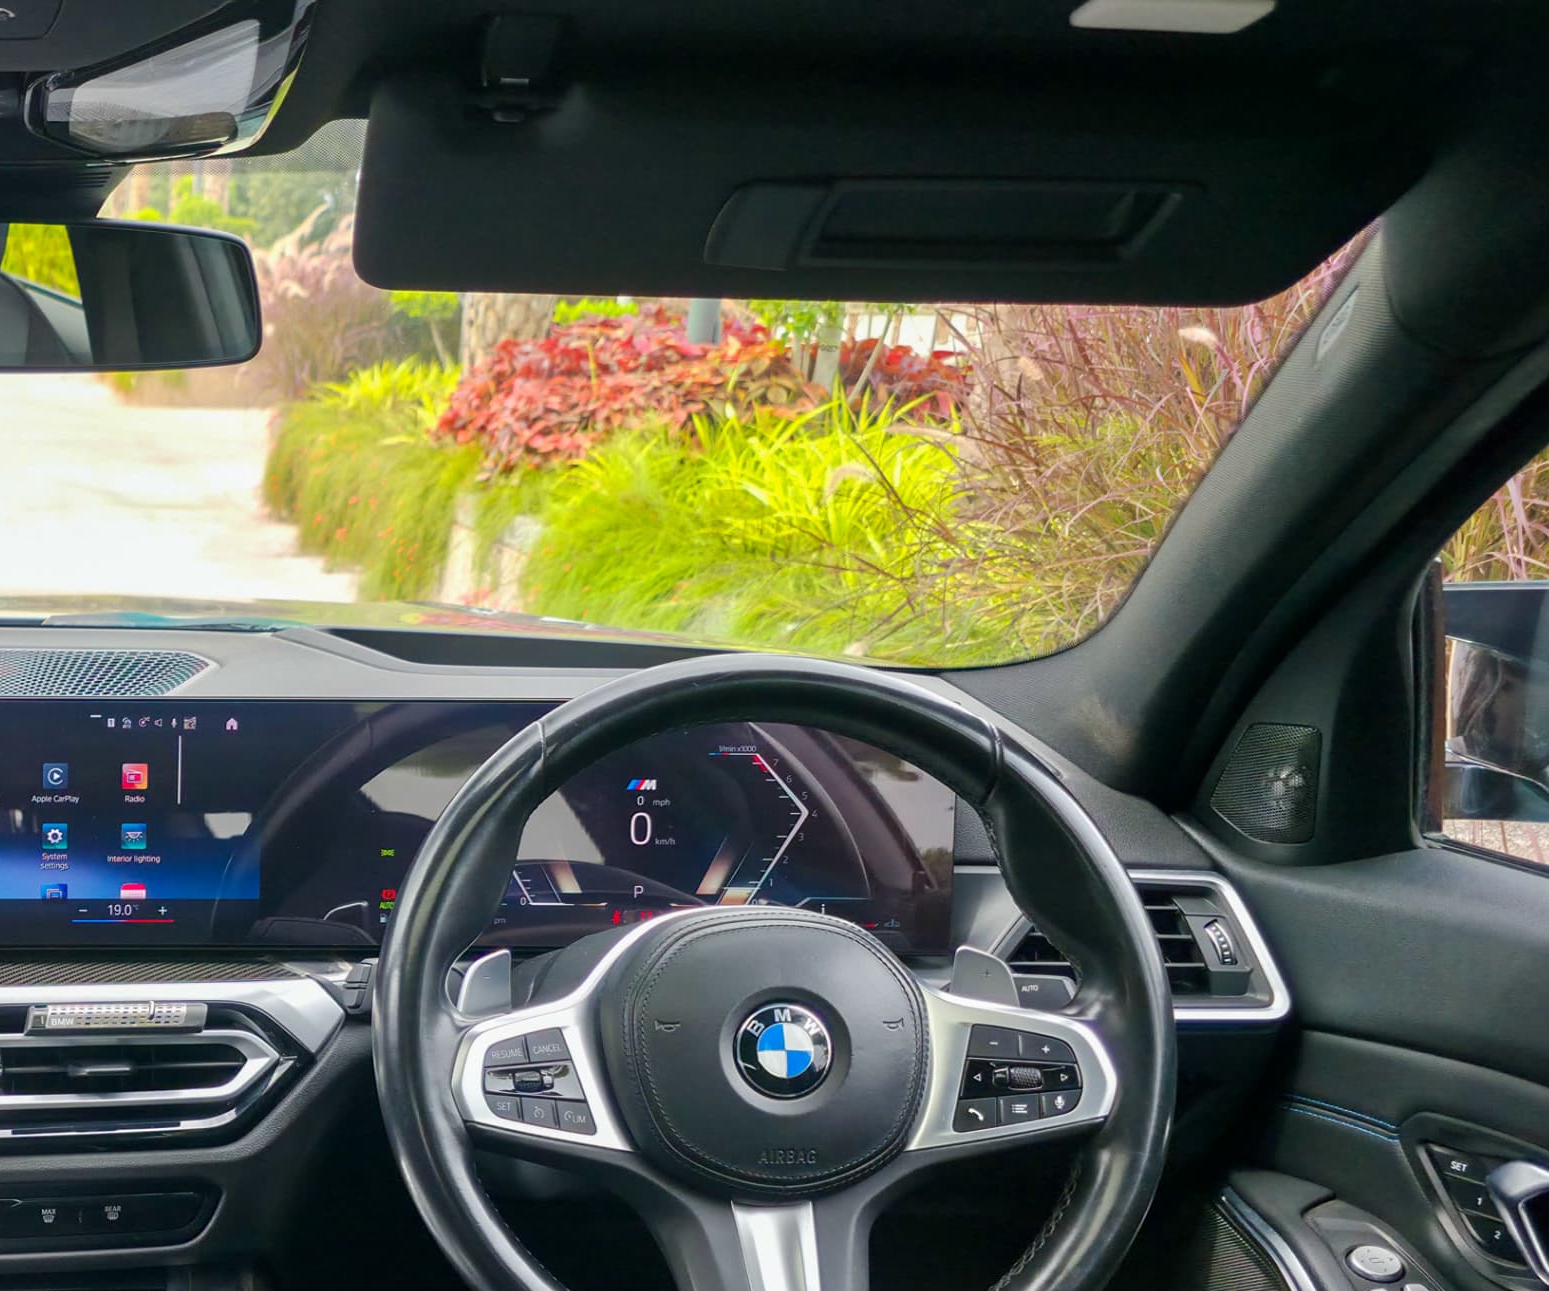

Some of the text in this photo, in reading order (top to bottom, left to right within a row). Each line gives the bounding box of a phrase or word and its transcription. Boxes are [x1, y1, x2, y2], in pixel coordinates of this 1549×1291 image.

[772, 759, 779, 767] 7
[786, 775, 792, 783] 6
[31, 794, 80, 804] Apple CarPlay
[124, 794, 146, 803] Radio
[801, 791, 808, 800] 5
[636, 796, 671, 807] 0 mph
[811, 809, 818, 818] 4
[630, 811, 676, 846] 0 km/h
[798, 832, 804, 841] 3
[41, 852, 68, 862] System
[107, 854, 161, 865] Interior lighting
[782, 855, 789, 864] 2
[40, 862, 69, 871] settings
[633, 885, 644, 898] P
[107, 904, 132, 916] 19.0
[1021, 983, 1039, 993] AUTO
[51, 1017, 75, 1027] BMW
[746, 1008, 821, 1037] BMW
[491, 1047, 524, 1060] RESUME
[532, 1042, 562, 1055] CANCEL
[496, 1101, 512, 1111] SET
[758, 1150, 816, 1164] AIRBAG
[1450, 1160, 1468, 1172] SET
[1476, 1196, 1483, 1206] 1
[1493, 1230, 1502, 1240] 2
